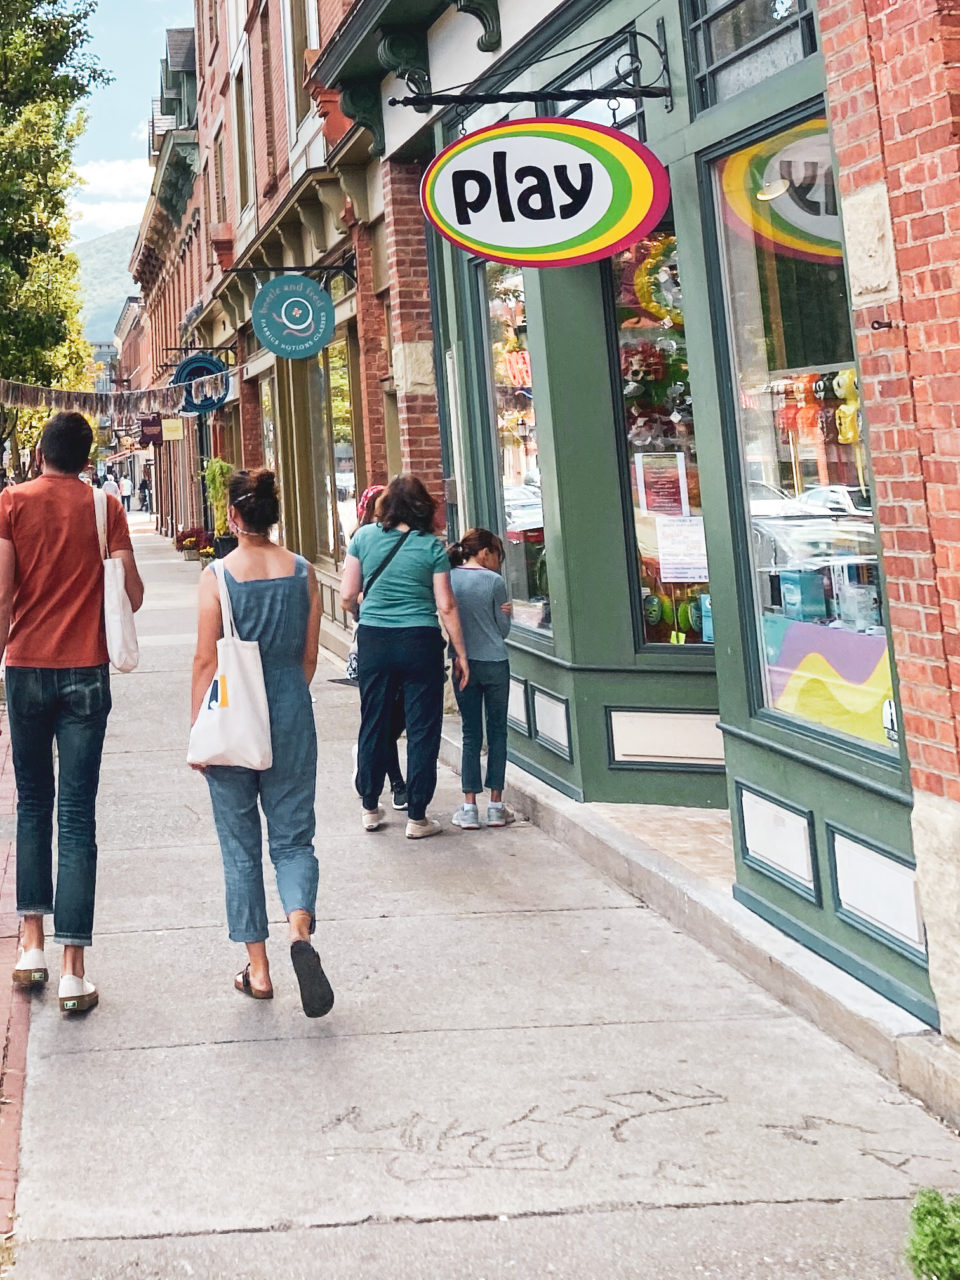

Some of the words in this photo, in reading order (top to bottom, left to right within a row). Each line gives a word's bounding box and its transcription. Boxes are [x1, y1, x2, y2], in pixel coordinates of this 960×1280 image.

[452, 151, 593, 225] play
[283, 282, 304, 292] and
[306, 286, 325, 307] fred
[261, 319, 279, 345] FABRICS
